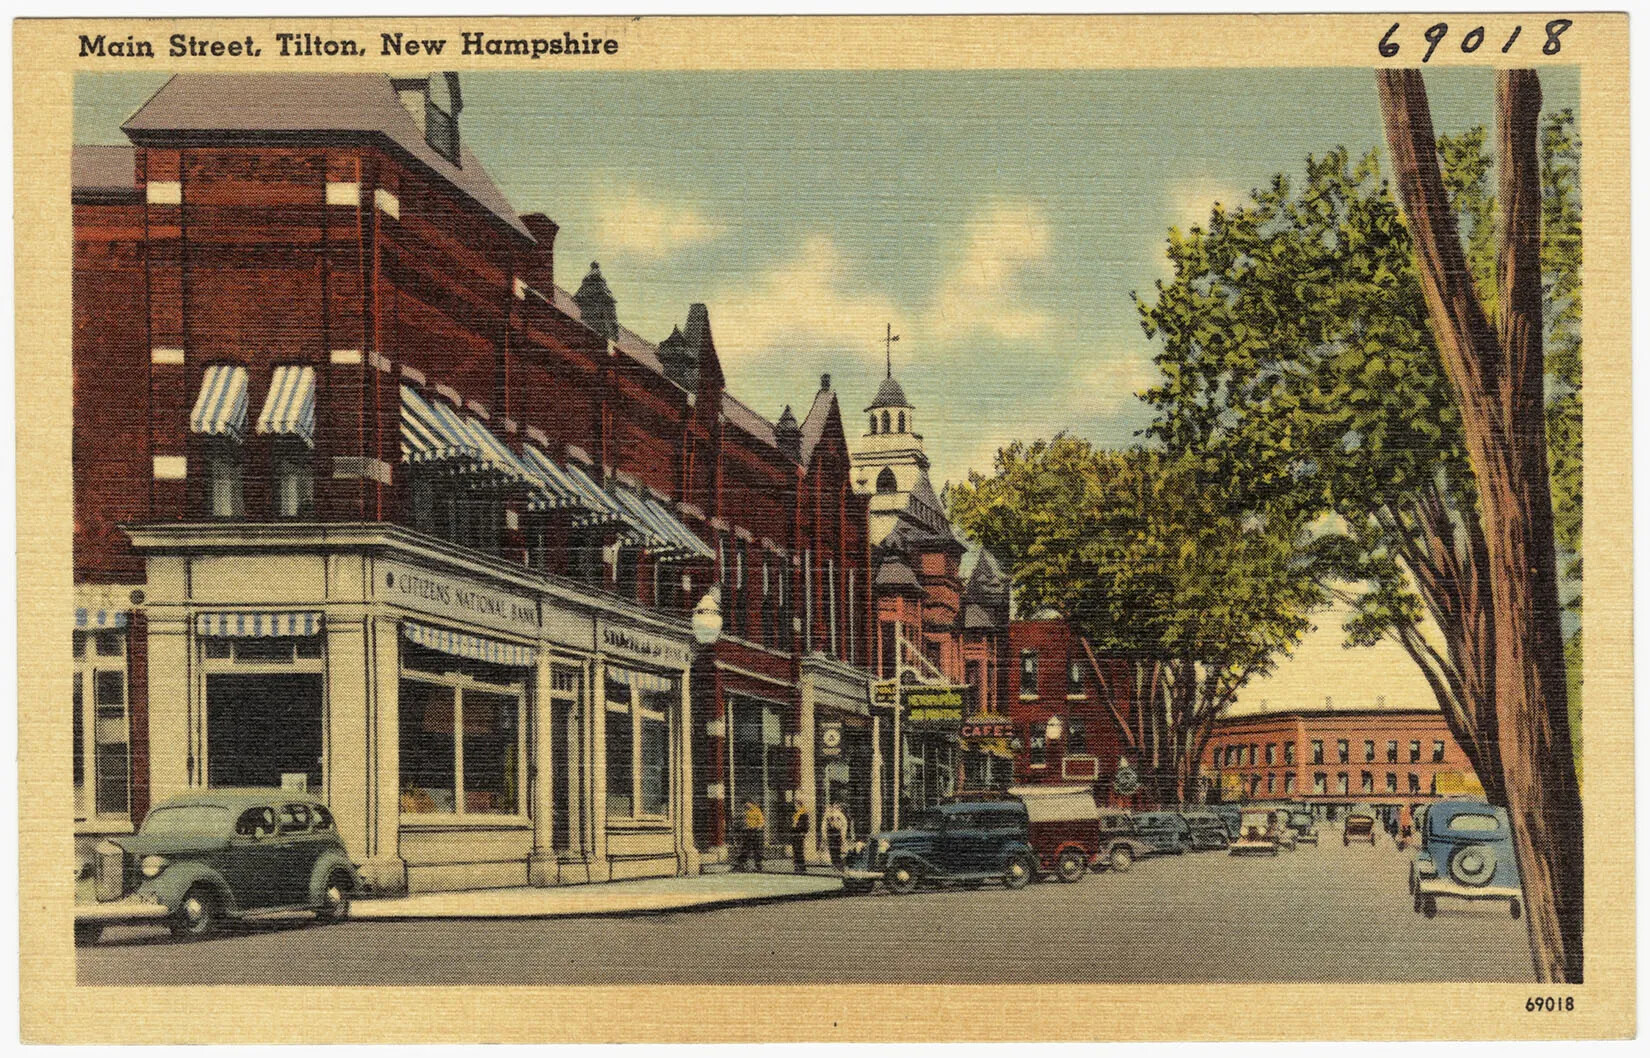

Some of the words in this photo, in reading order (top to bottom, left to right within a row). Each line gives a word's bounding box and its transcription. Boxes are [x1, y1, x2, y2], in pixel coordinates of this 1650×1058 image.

[1378, 18, 1574, 63] 69018
[400, 573, 451, 606] CITIZENS
[455, 588, 508, 619] NATIONAL
[511, 603, 536, 626] BANK
